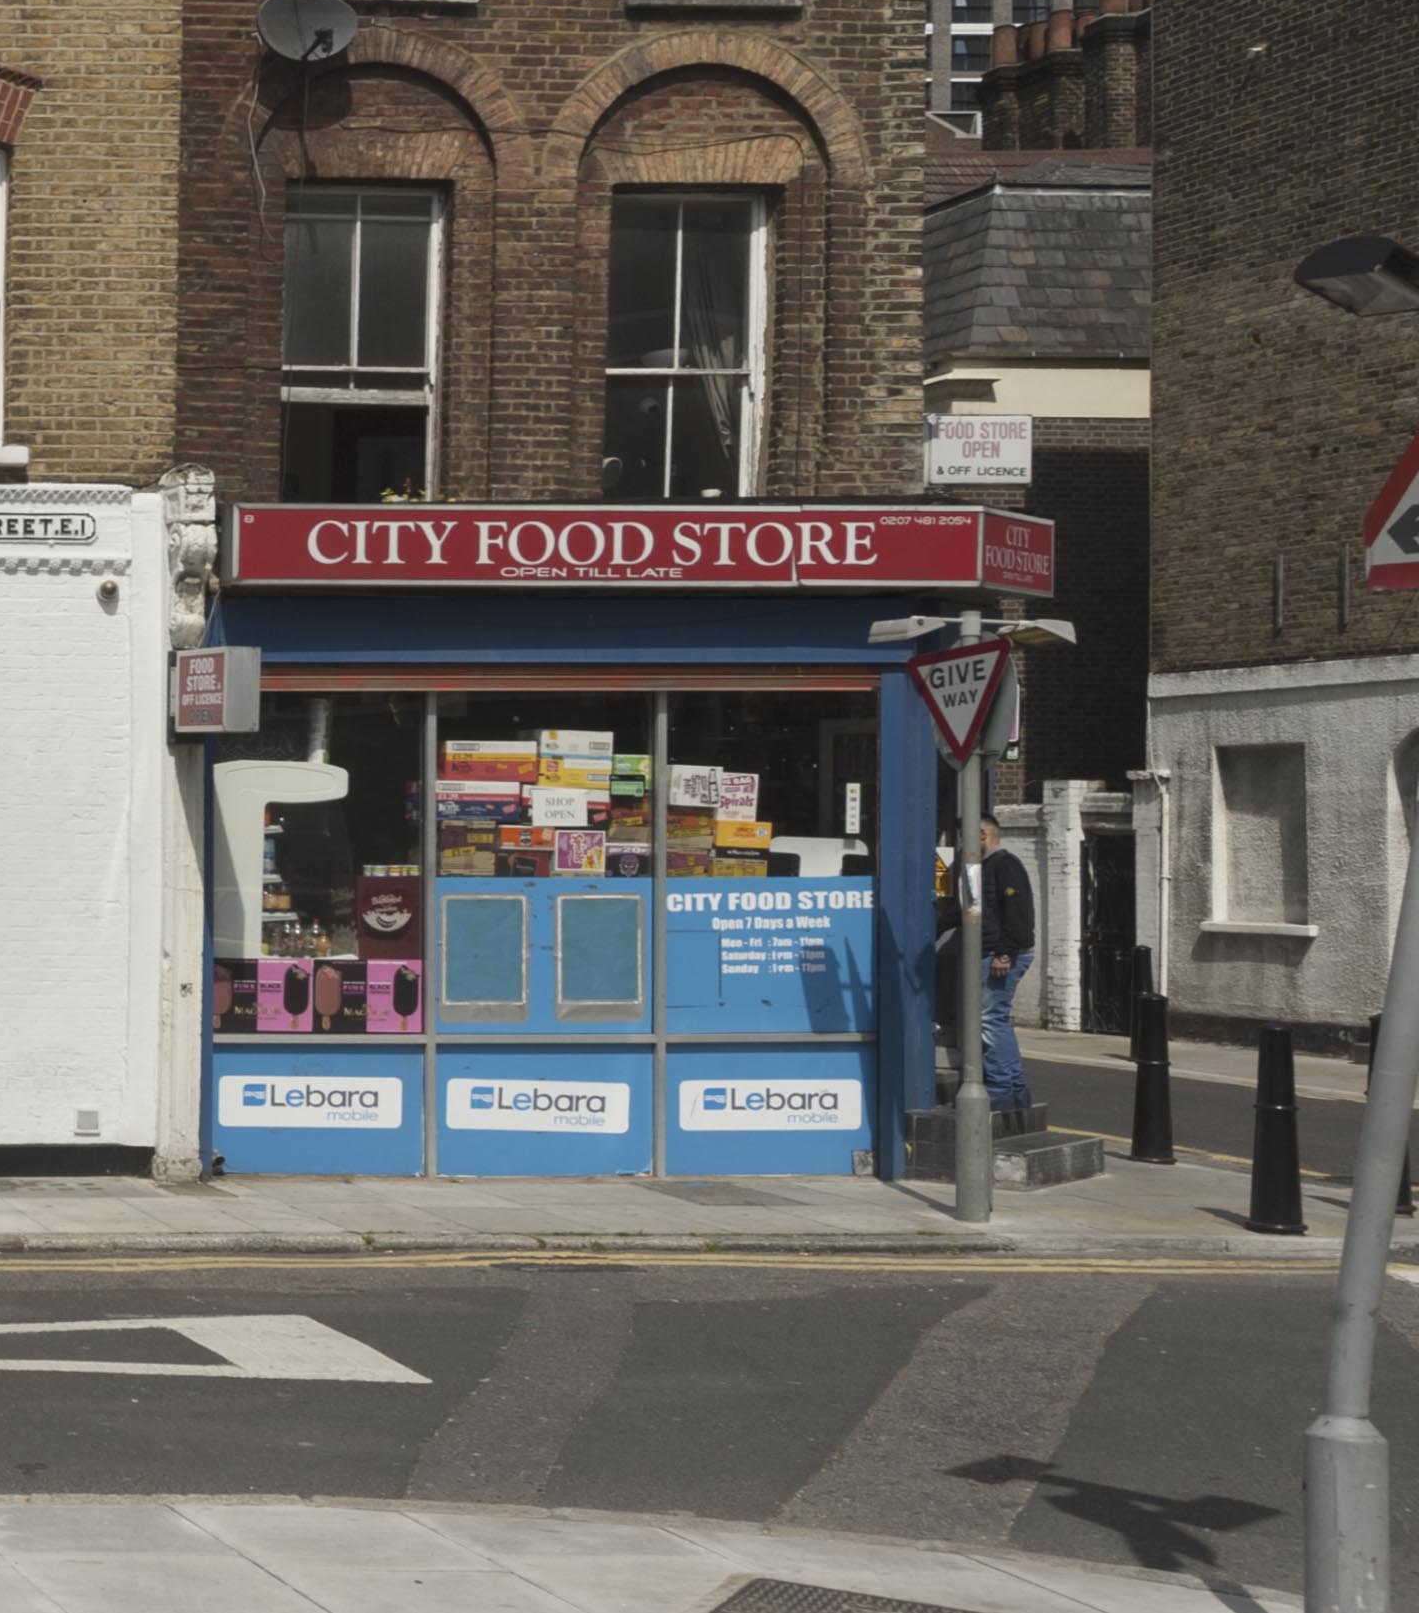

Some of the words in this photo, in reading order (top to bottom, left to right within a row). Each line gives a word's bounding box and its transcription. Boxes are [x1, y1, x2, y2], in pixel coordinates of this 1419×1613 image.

[937, 421, 975, 439] FOOD
[980, 422, 1027, 439] STORE
[962, 441, 1000, 458] OPEN
[936, 466, 944, 475] &
[948, 466, 971, 475] OFF
[977, 467, 1027, 477] LICENCE
[879, 516, 912, 525] 0207
[914, 516, 936, 525] 481
[938, 516, 971, 525] 2054
[307, 520, 458, 564] CITY
[474, 521, 654, 565] FOOD
[671, 521, 878, 566] STORE
[1006, 525, 1031, 548] CITY
[985, 544, 1015, 569] FOOD
[1016, 551, 1050, 575] STORE
[500, 567, 567, 577] OPEN
[574, 567, 620, 578] TILL
[626, 568, 683, 578] LATE
[189, 657, 214, 674] FOOD
[929, 659, 987, 689] GIVE
[186, 674, 217, 691] STORE
[182, 693, 195, 706] OFF
[195, 692, 224, 705] LICENCE
[942, 689, 978, 708] WAY
[545, 797, 575, 806] SHOP
[545, 810, 575, 819] OPEN
[666, 893, 723, 912] CITY
[728, 892, 791, 911] FOOD
[797, 890, 874, 909] STORE
[712, 917, 743, 931] Open
[745, 917, 752, 929] 7
[754, 917, 784, 930] Days
[785, 919, 794, 929] a
[796, 916, 831, 929] Week
[721, 938, 742, 948] Mon
[749, 937, 763, 948] Fri
[721, 951, 766, 961] Saturday
[721, 964, 759, 974] Sunday
[270, 1085, 379, 1107] Lebara
[498, 1087, 606, 1113] Lebara
[731, 1088, 838, 1110] Lebara
[326, 1110, 379, 1121] mobile
[554, 1114, 606, 1126] mobile
[787, 1112, 838, 1123] mobile
